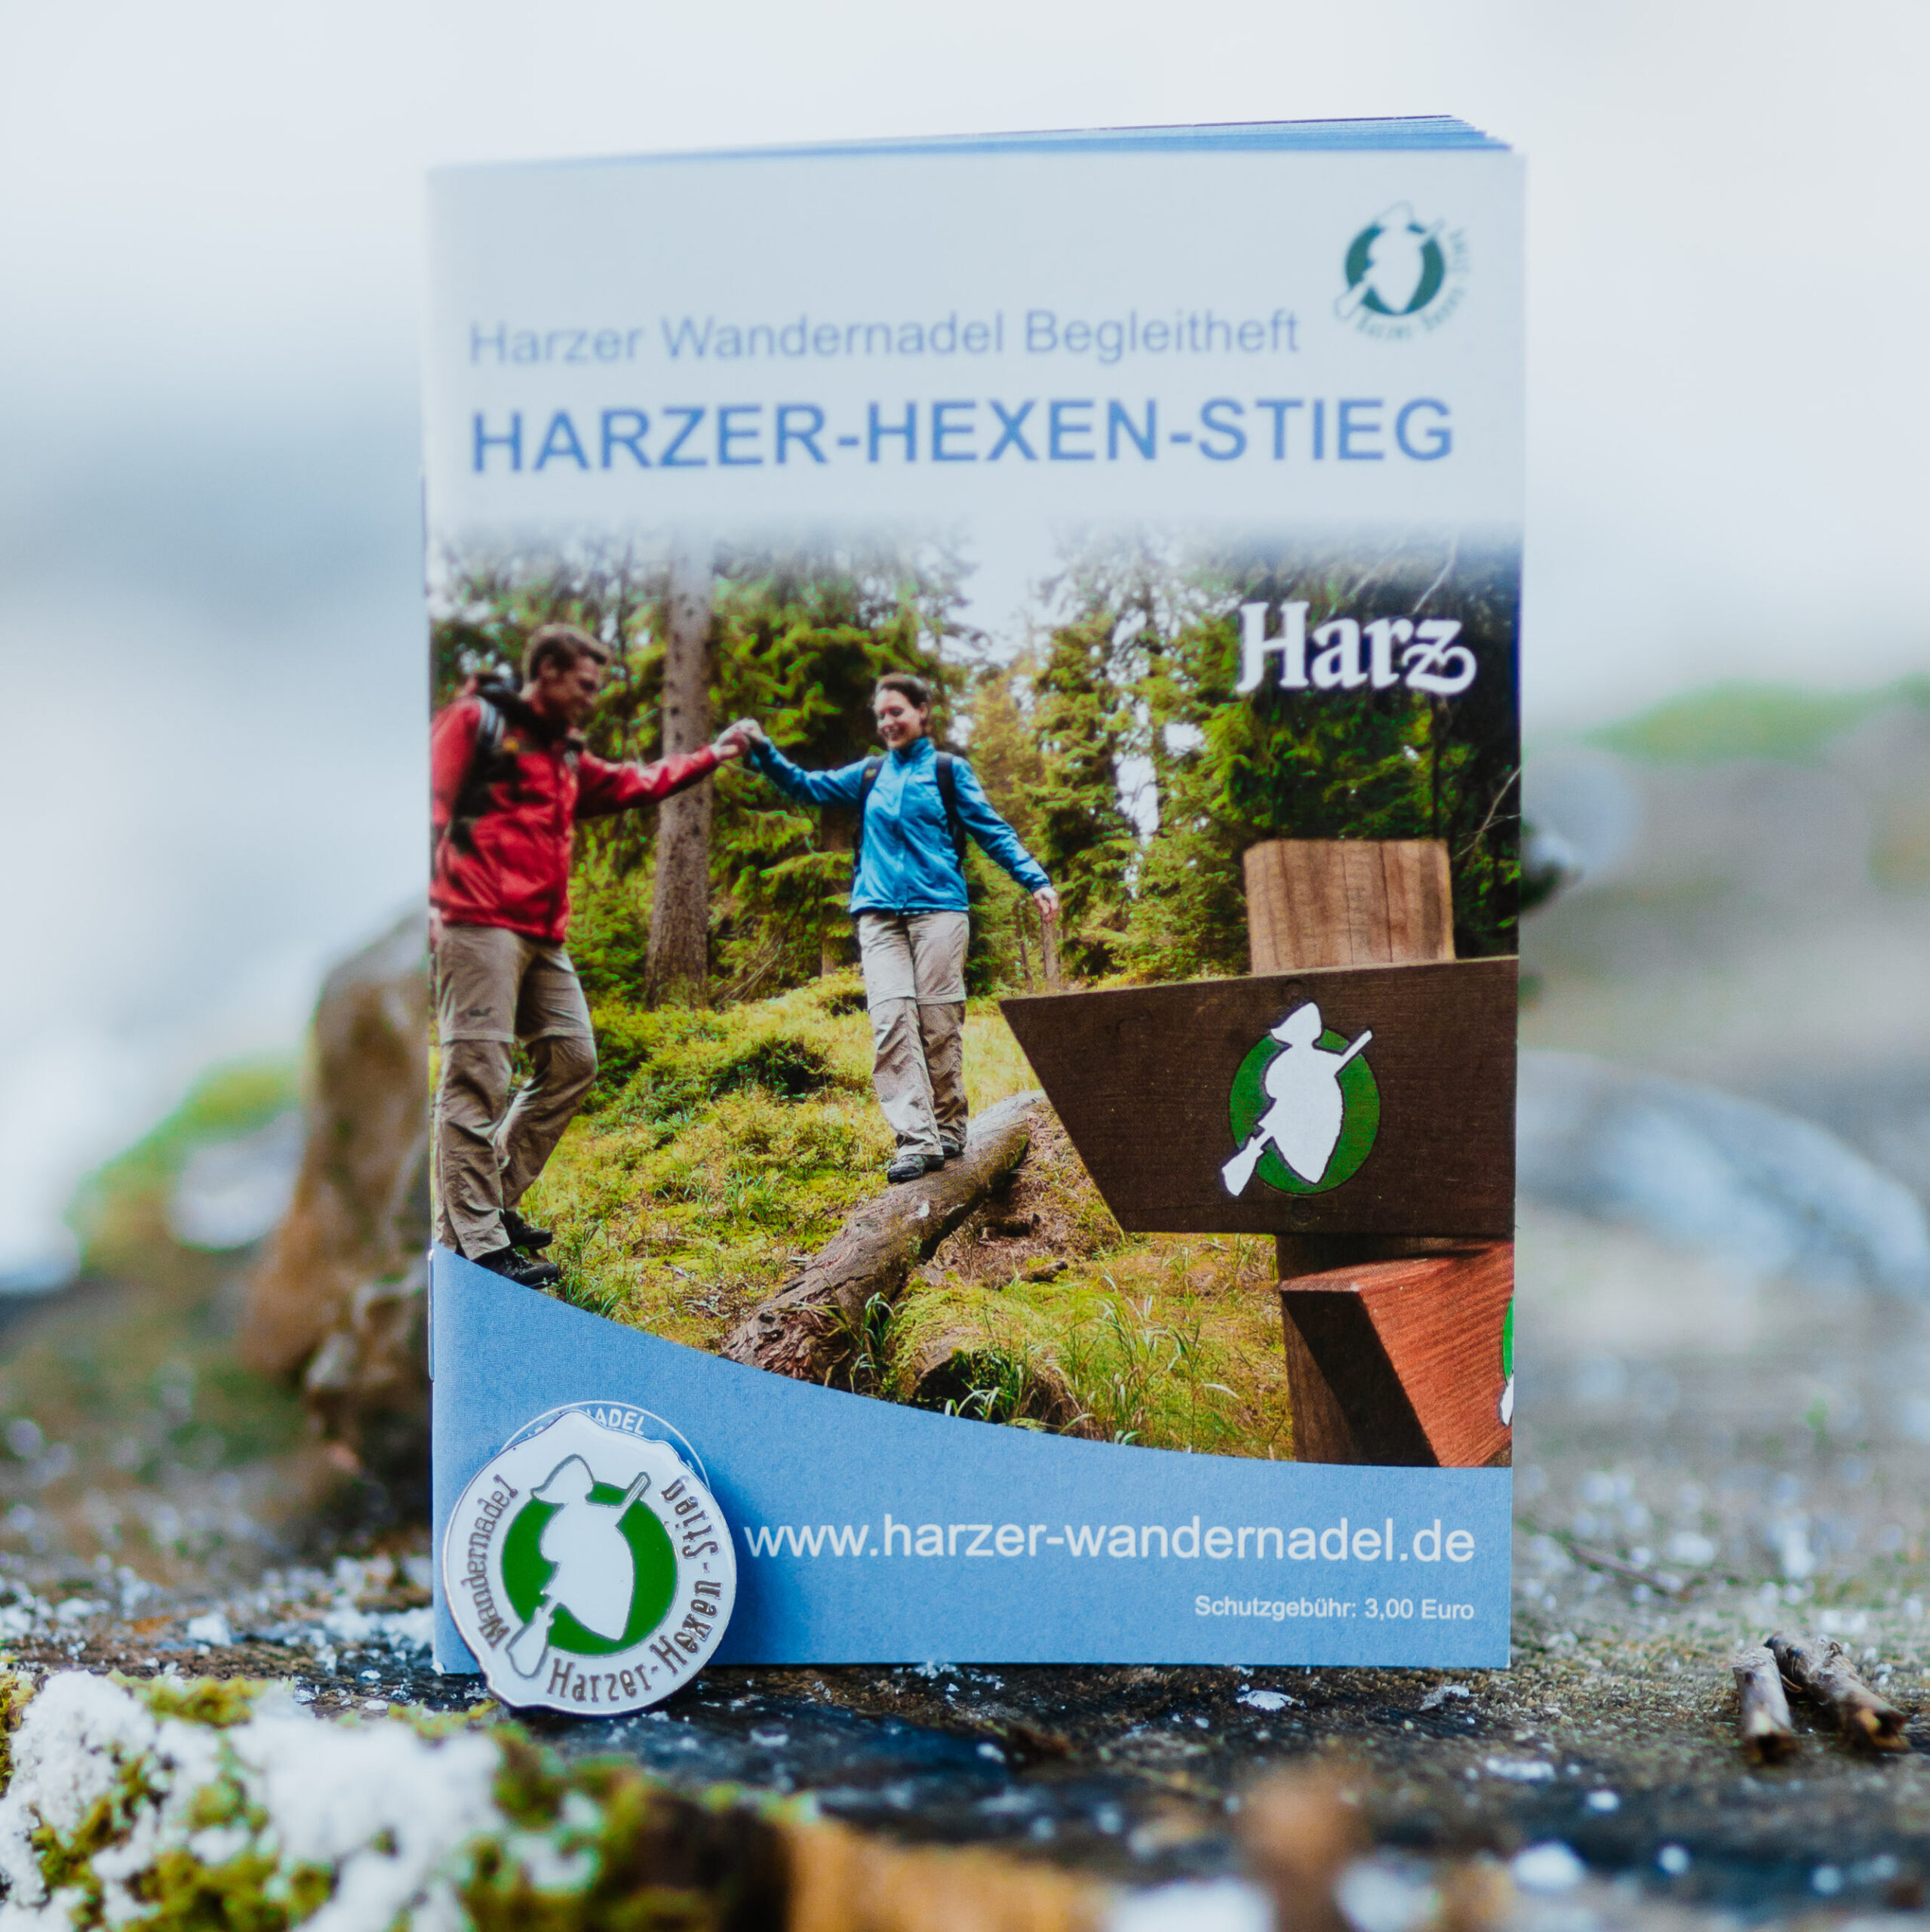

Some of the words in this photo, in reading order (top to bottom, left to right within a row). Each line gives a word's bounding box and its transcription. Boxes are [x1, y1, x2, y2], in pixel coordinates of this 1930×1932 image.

[469, 321, 645, 368] Harzer
[659, 311, 1004, 361] Wandernadel
[1024, 308, 1301, 366] Begleitheft
[471, 397, 1453, 475] HARZER-HEXEN-STIEG
[1235, 600, 1477, 696] Harz
[586, 1407, 645, 1436] ADEL
[460, 1474, 519, 1649] Wandernadel
[743, 1513, 1476, 1563] www.harzer-wandernadel.de
[1194, 1595, 1357, 1622] Schutzgebühr:
[1364, 1597, 1414, 1621] 3,00
[1421, 1598, 1475, 1620] Euro
